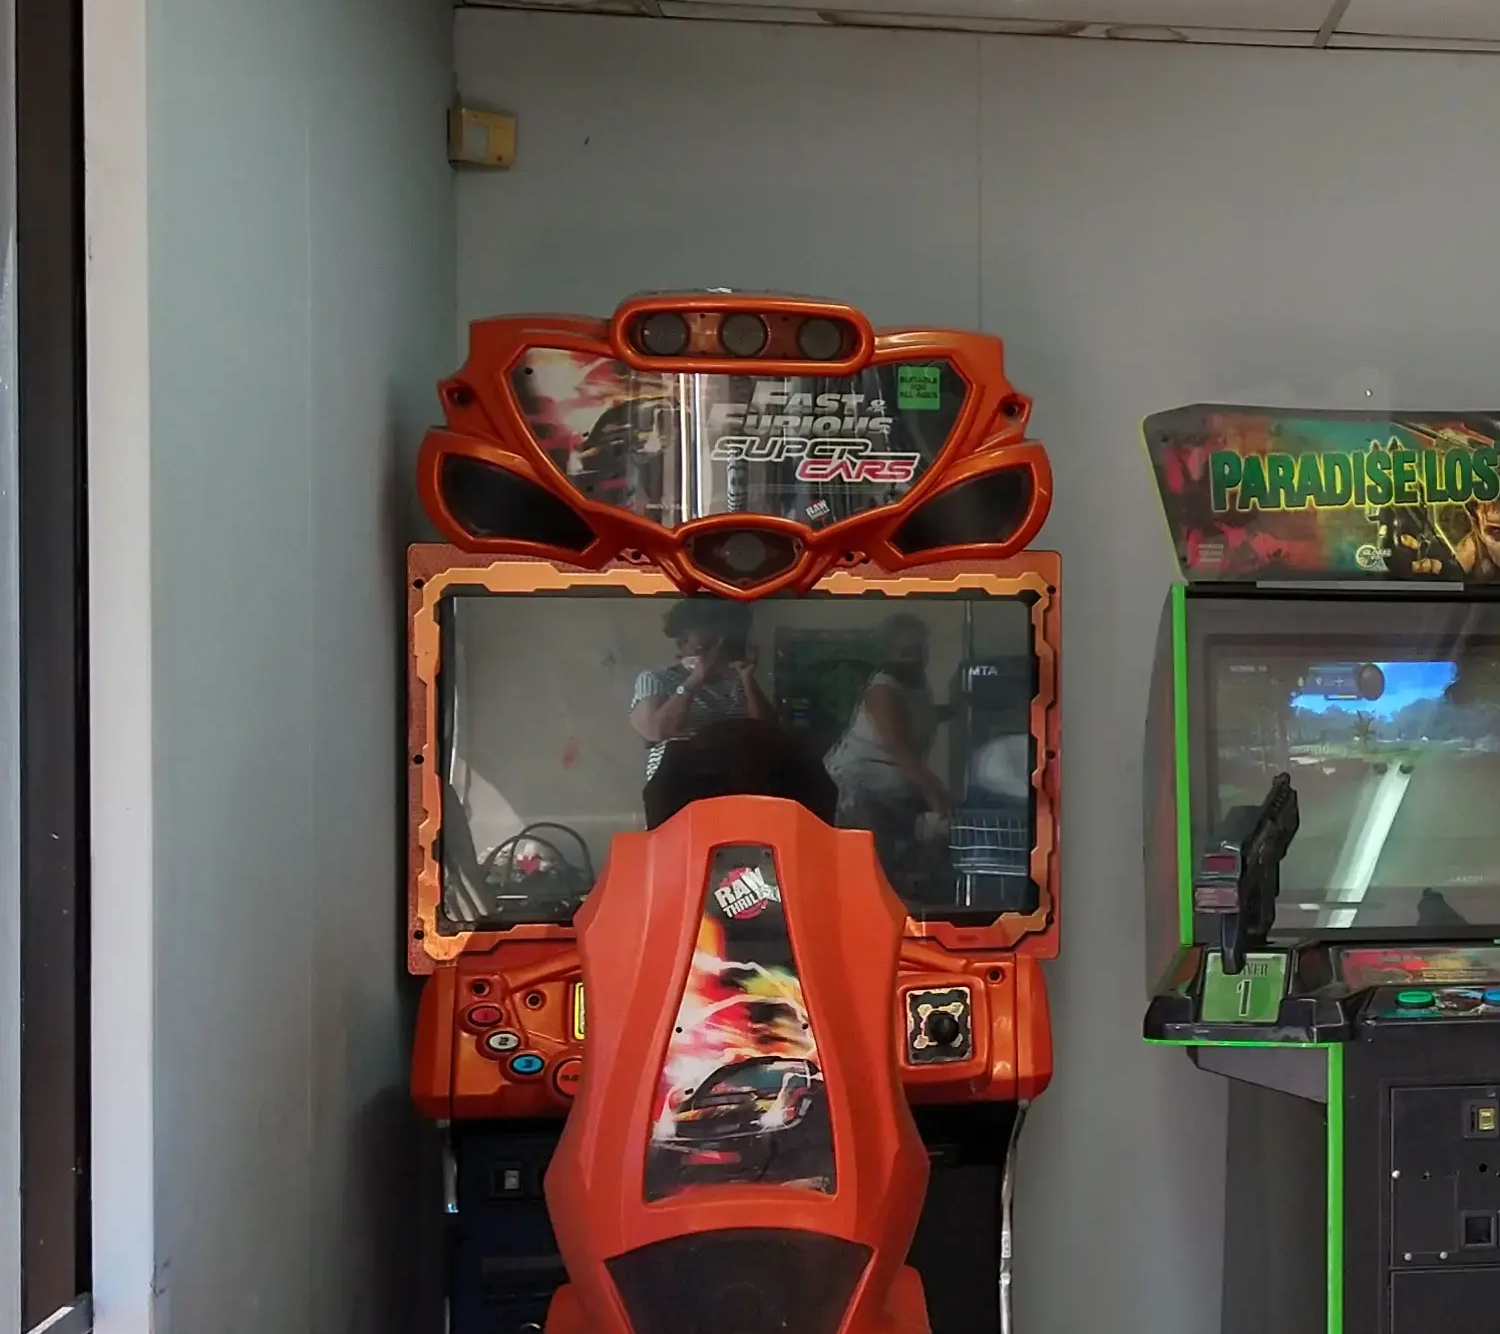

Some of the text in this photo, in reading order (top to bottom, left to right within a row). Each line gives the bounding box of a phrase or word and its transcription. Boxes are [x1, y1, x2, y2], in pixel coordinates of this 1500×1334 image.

[751, 380, 888, 415] FAST &
[707, 402, 894, 436] FURIOUS
[711, 436, 921, 465] SUPER
[796, 457, 915, 482] CARS
[1210, 447, 1421, 512] PARADISE
[714, 867, 766, 908] RAW
[1236, 979, 1252, 1017] 1
